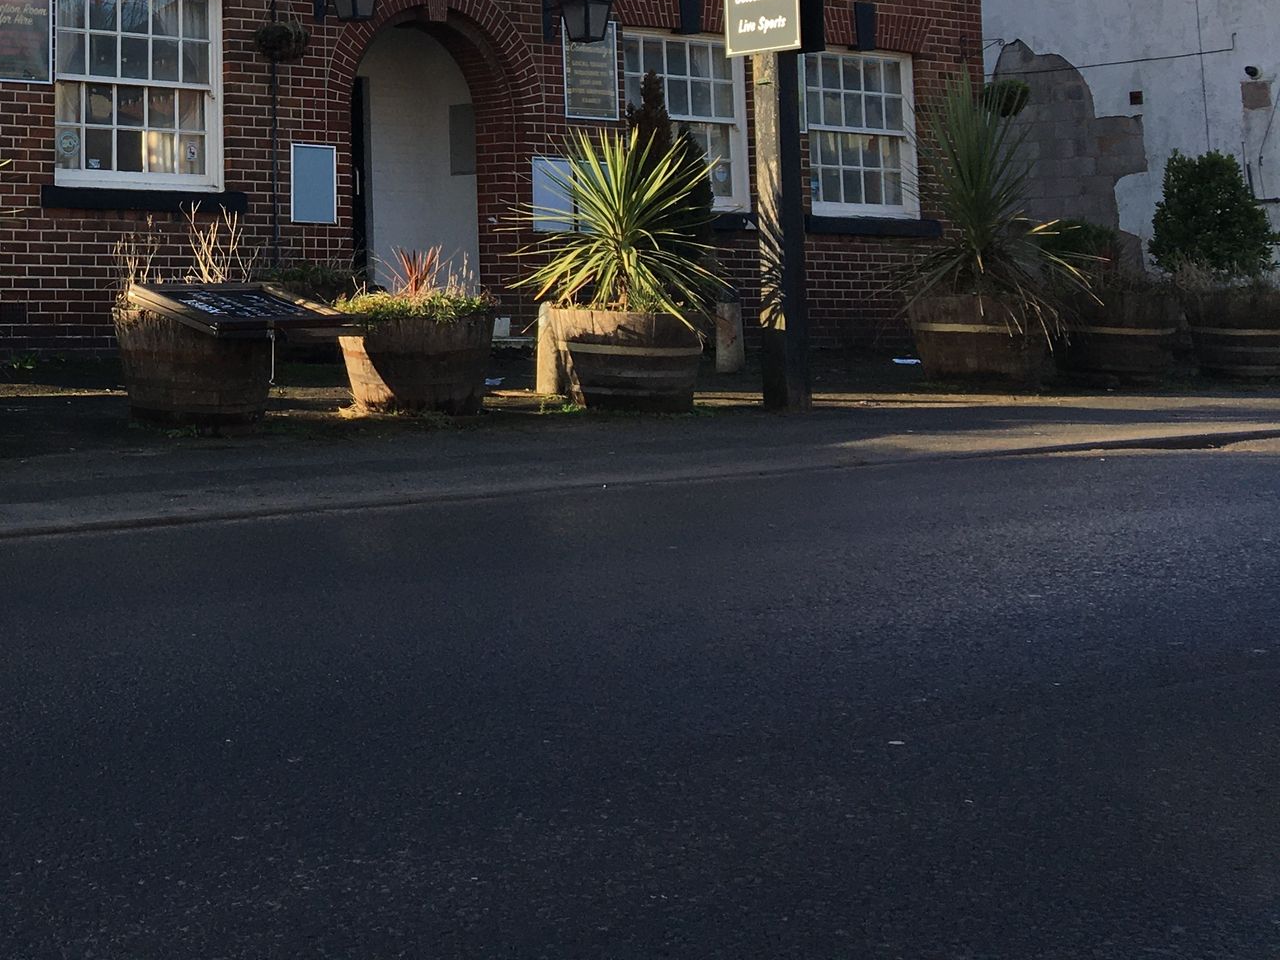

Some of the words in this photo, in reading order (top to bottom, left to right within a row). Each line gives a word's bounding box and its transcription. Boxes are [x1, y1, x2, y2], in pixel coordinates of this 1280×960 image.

[23, 3, 48, 16] Room
[14, 14, 33, 26] Hire
[738, 18, 756, 34] Live
[757, 14, 786, 34] Sports
